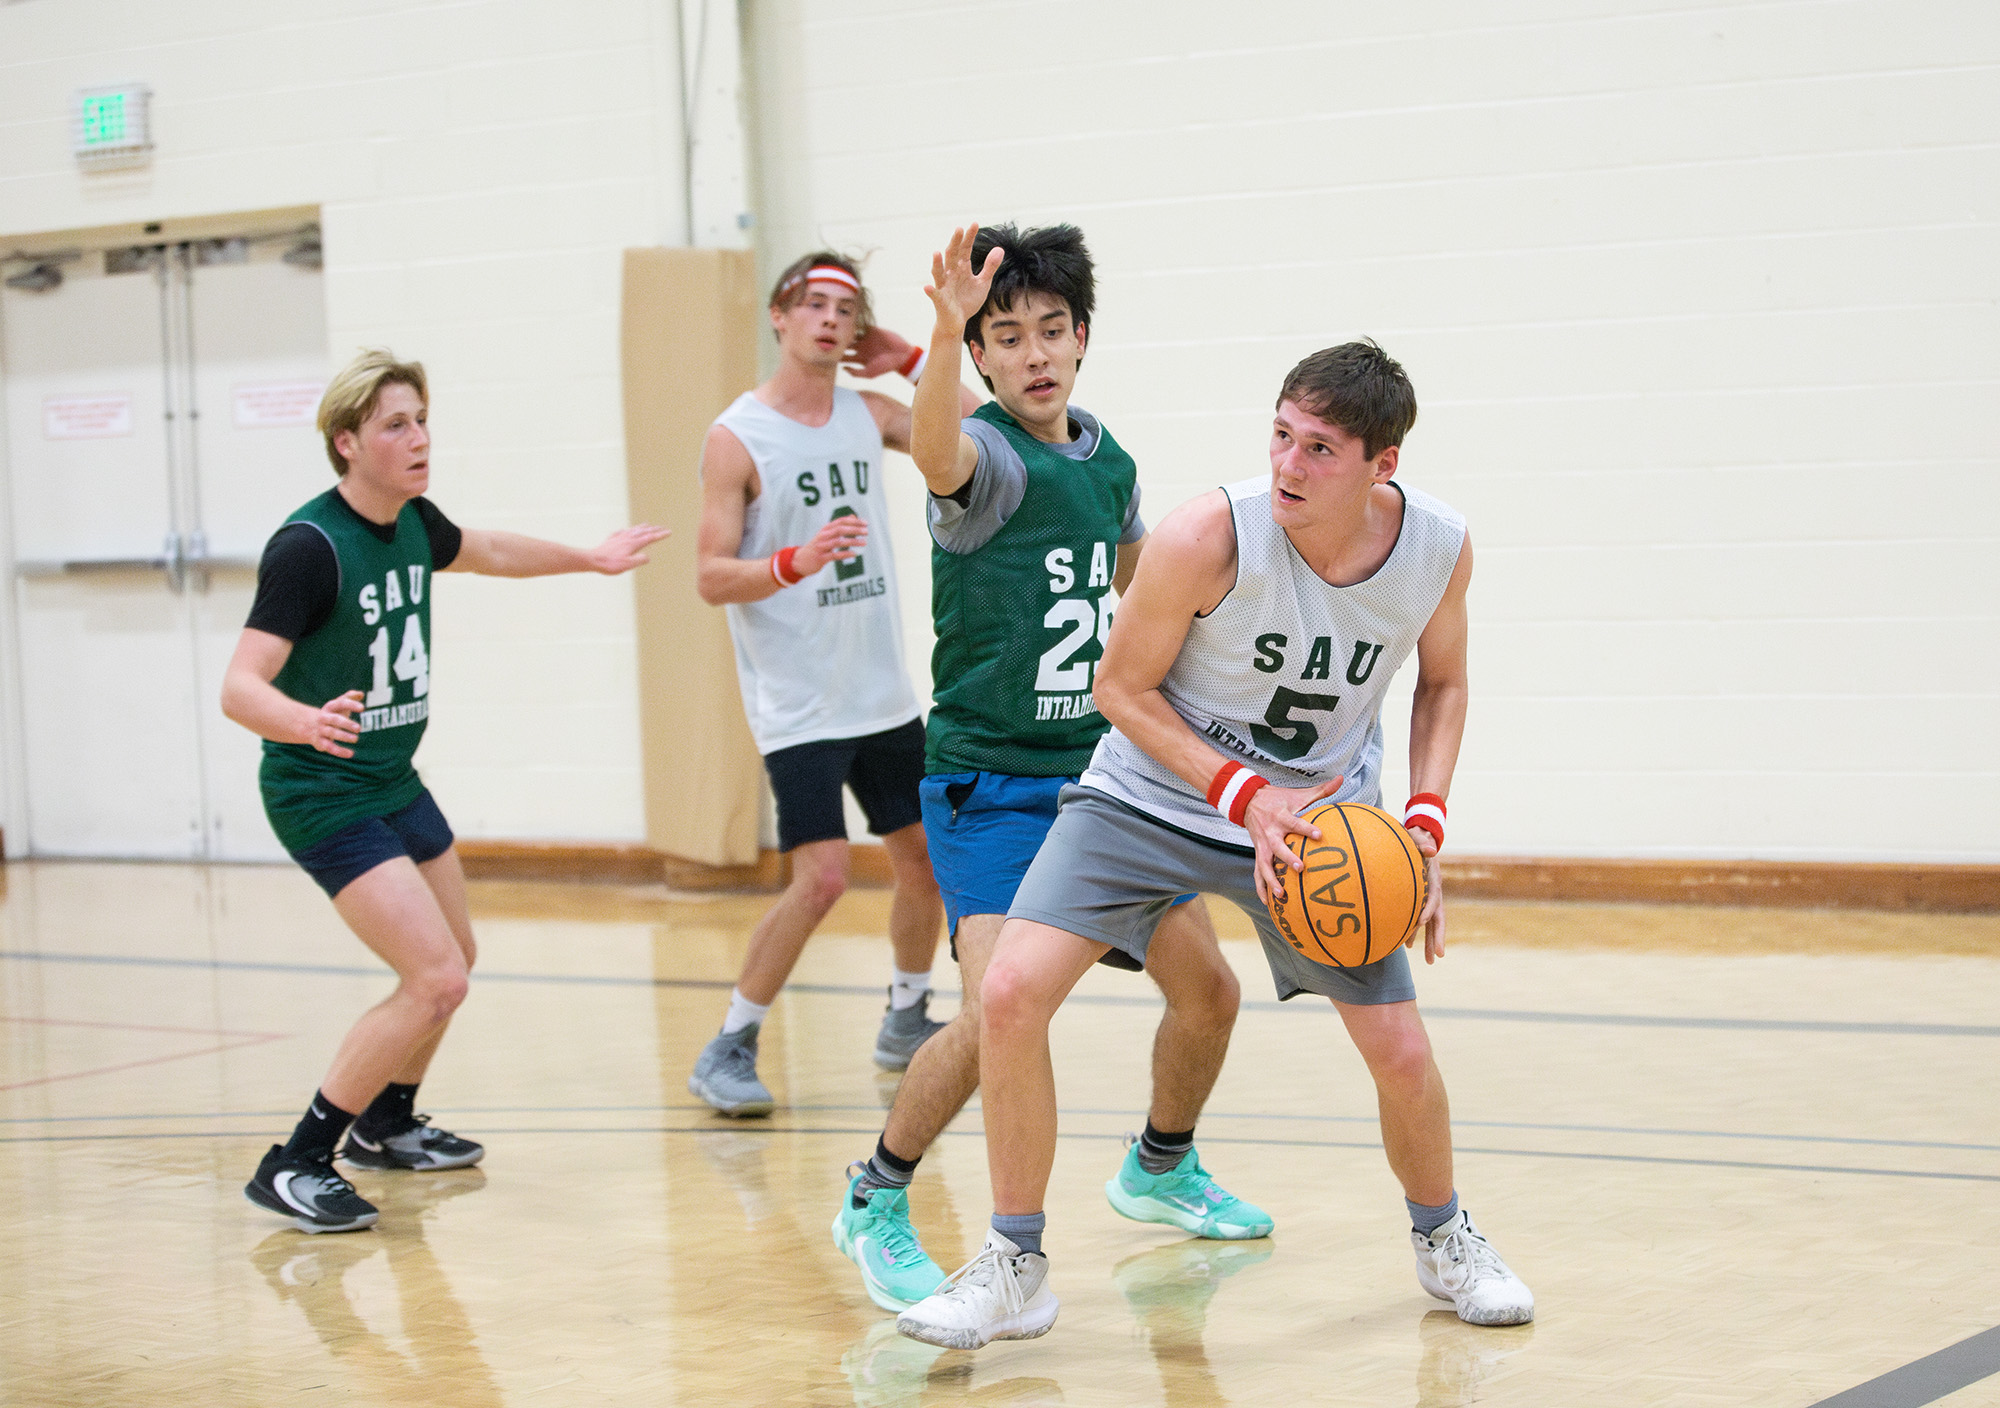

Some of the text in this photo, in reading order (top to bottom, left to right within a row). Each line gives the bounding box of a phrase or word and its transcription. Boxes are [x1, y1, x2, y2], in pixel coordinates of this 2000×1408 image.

[796, 460, 868, 507] SAU
[358, 564, 425, 626] SAU
[1044, 541, 1109, 594] SA
[366, 612, 428, 708] 14
[1253, 632, 1385, 686] SAU
[1249, 685, 1341, 762] 5
[1306, 845, 1362, 939] SAU
